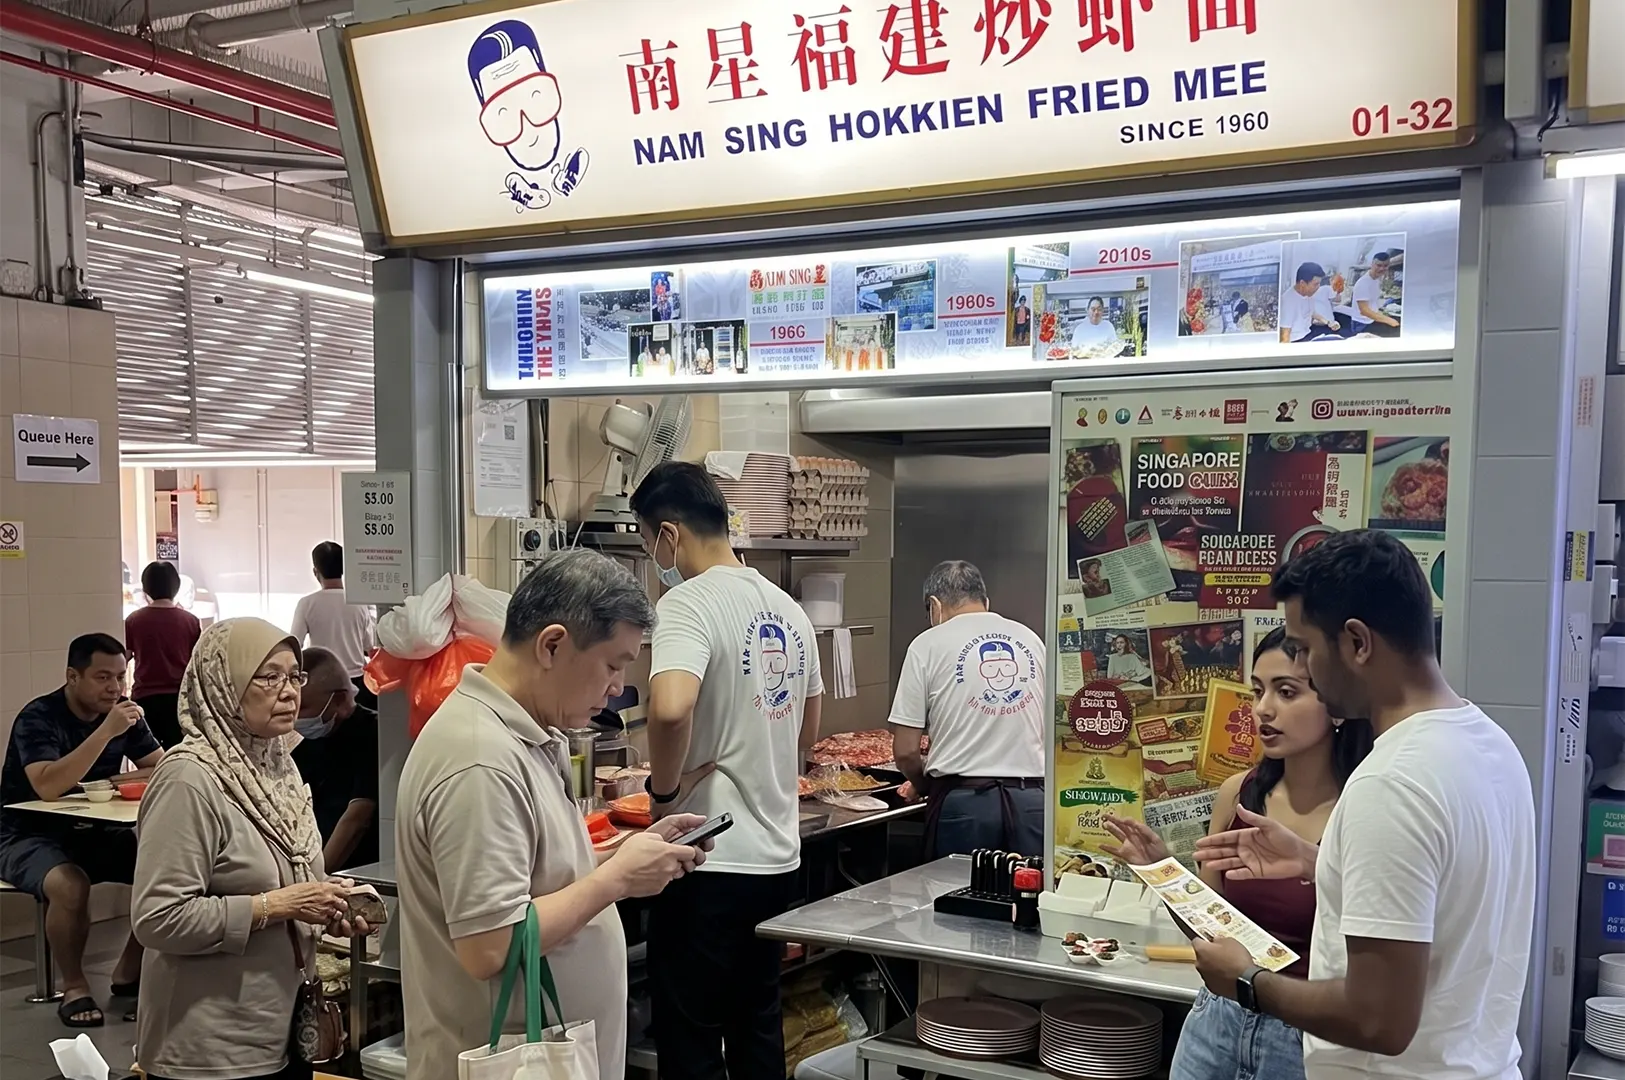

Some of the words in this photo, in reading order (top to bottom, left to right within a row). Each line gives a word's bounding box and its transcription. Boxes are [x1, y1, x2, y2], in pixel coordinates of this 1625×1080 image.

[634, 131, 705, 165] NAM
[725, 119, 808, 155] SING
[829, 93, 1003, 143] HOKKIEN
[1028, 75, 1150, 119] FRIED
[1174, 60, 1267, 101] MEE
[1351, 97, 1453, 137] 01-32
[1119, 117, 1205, 145] SINCE
[1214, 110, 1270, 136] 1960
[1098, 246, 1152, 265] 2010s
[18, 429, 61, 443] Queue
[65, 432, 94, 445] Here
[1137, 452, 1241, 470] SINGAPORE
[1137, 472, 1184, 489] FOOD
